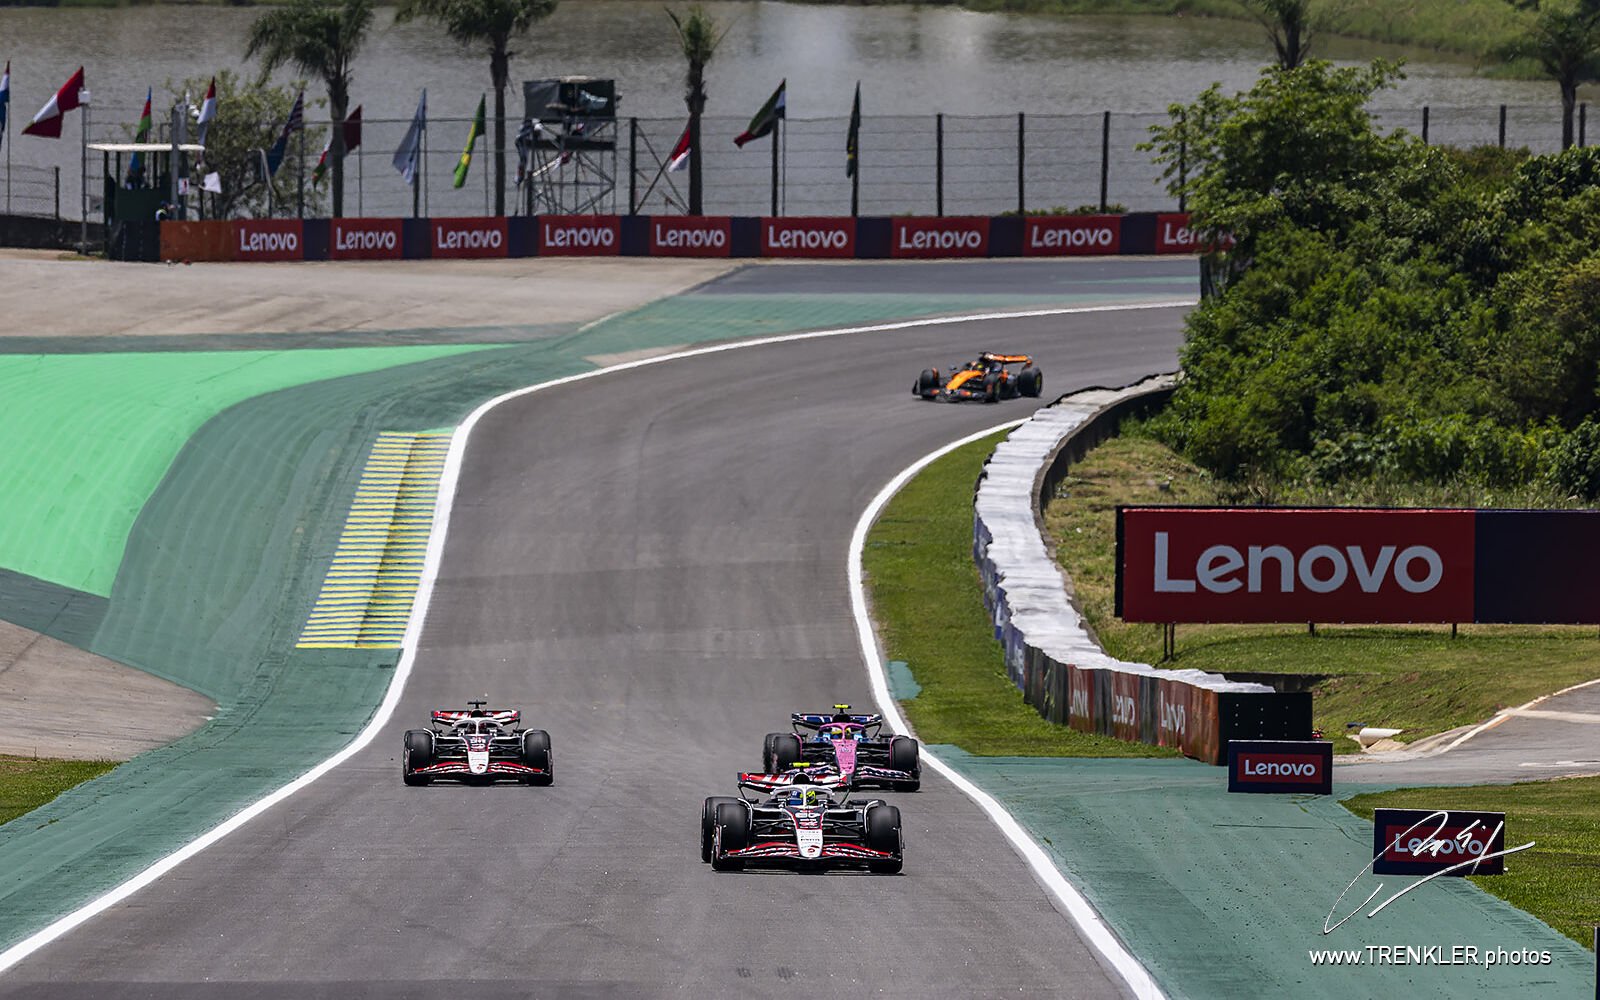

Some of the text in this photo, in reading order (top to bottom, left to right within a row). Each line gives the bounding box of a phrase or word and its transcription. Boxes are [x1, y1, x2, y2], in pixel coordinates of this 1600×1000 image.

[240, 228, 297, 251] Lenovo
[336, 226, 396, 249] Lenovo
[437, 226, 502, 248] Lenovo
[544, 224, 614, 247] Lenovo
[655, 224, 726, 247] Lenovo
[768, 225, 848, 248] Lenovo
[900, 226, 981, 248] Lenovo
[1031, 225, 1113, 247] Lenovo
[1154, 531, 1443, 593] Lenovo
[1244, 759, 1316, 777] Lenovo
